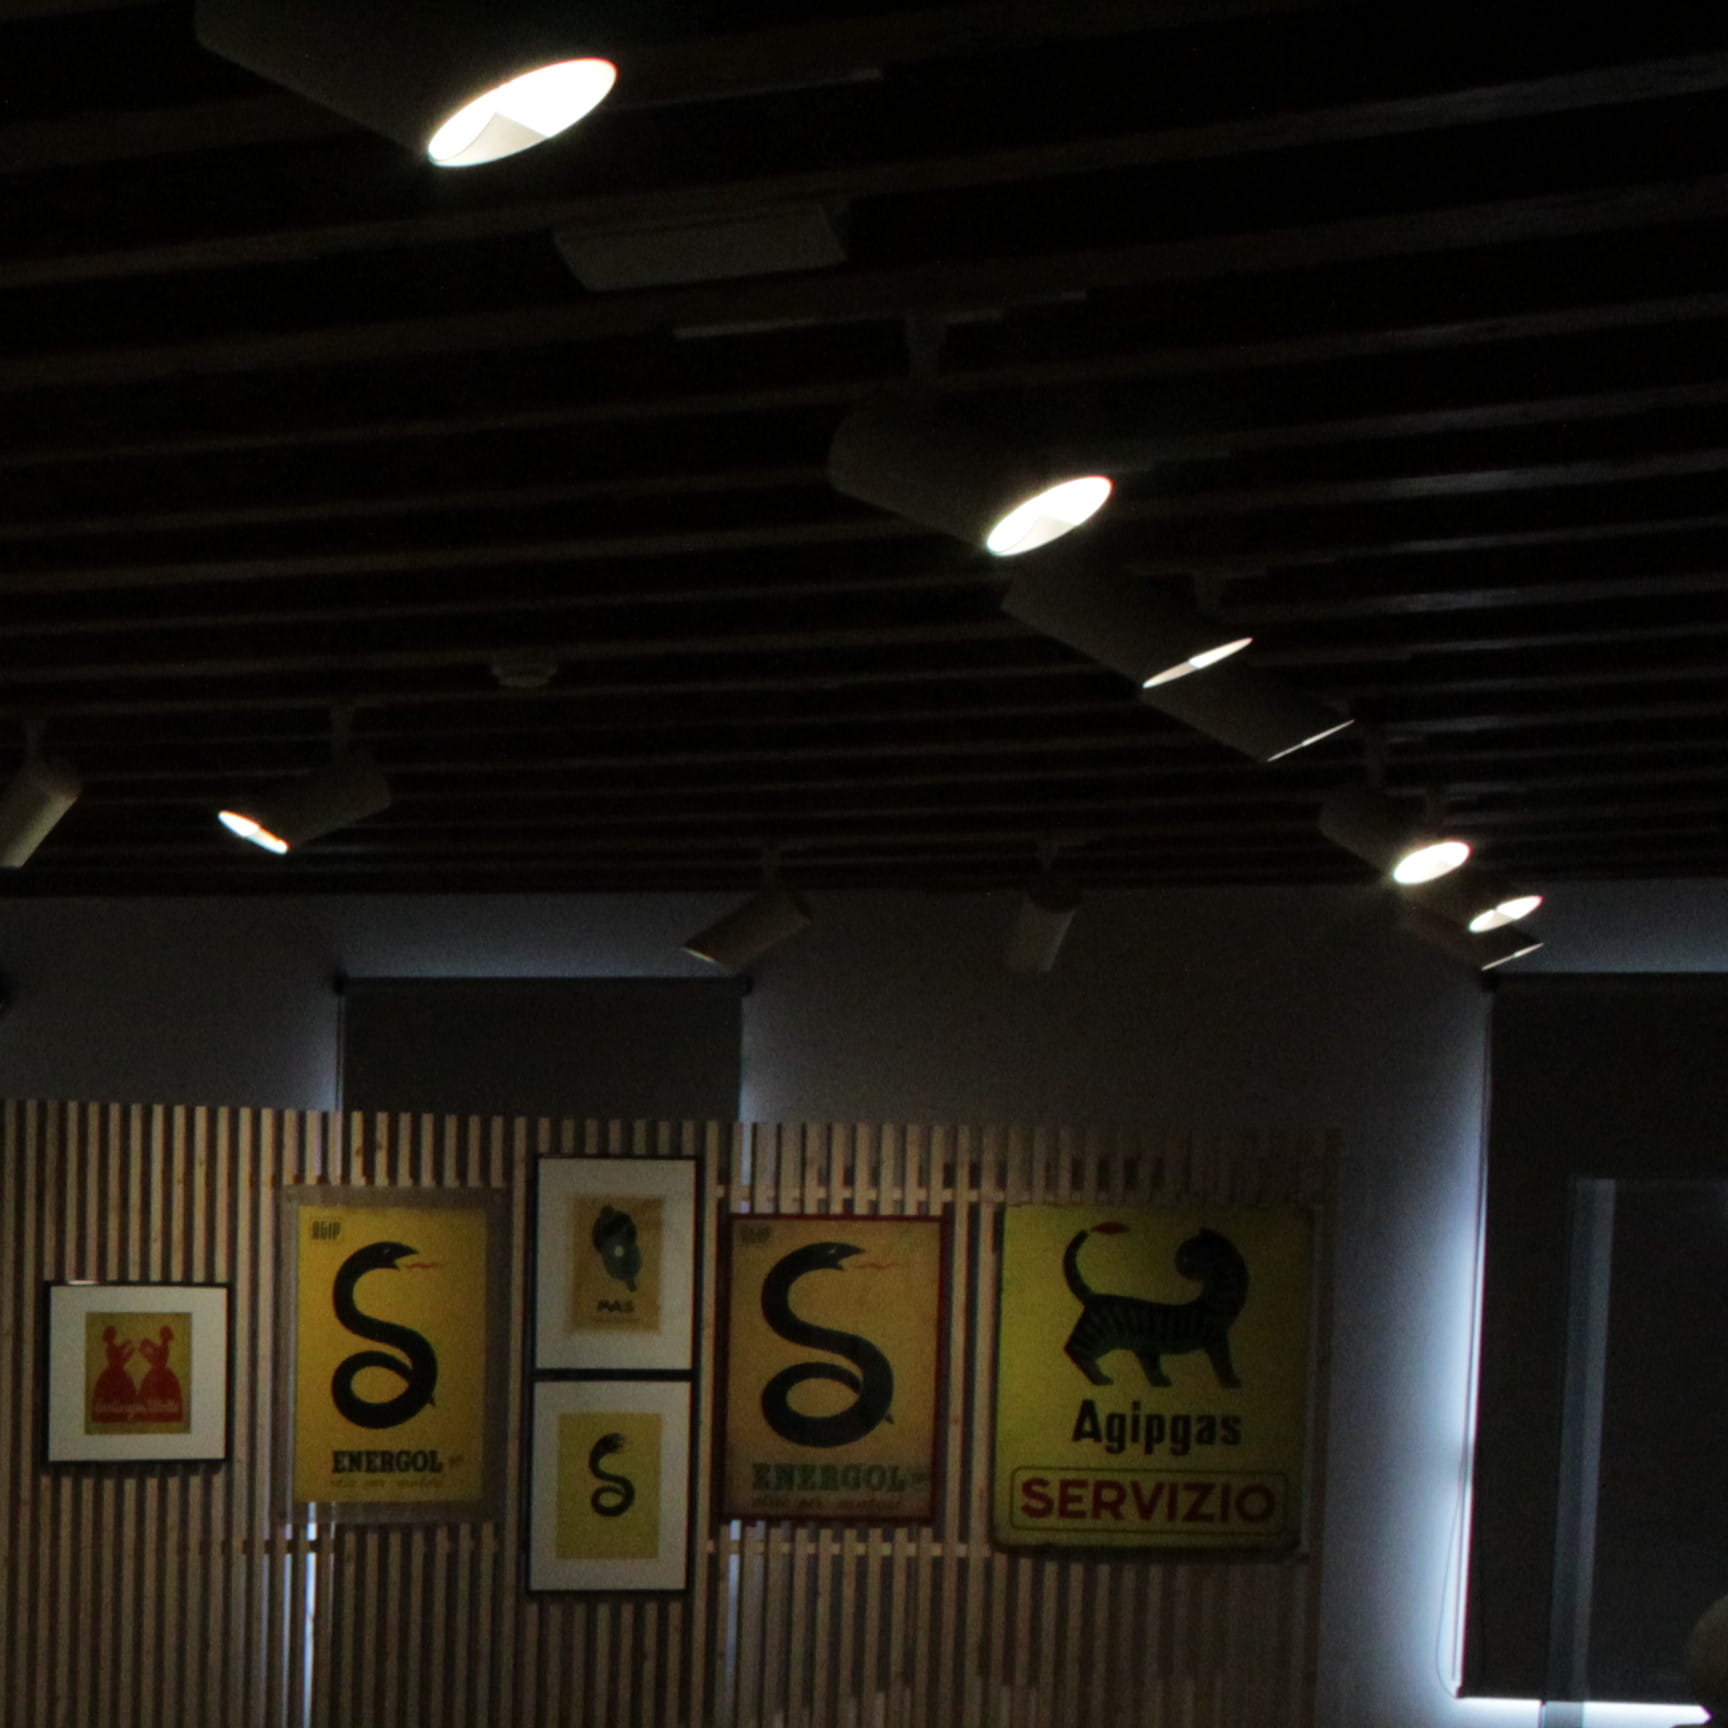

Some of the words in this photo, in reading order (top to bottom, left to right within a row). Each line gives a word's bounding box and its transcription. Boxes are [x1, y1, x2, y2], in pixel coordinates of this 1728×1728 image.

[1072, 1398, 1242, 1456] Agipgas
[331, 1450, 443, 1473] ENERGOL
[752, 1463, 906, 1492] ENERGOL
[1020, 1476, 1276, 1524] SERVIZIO
